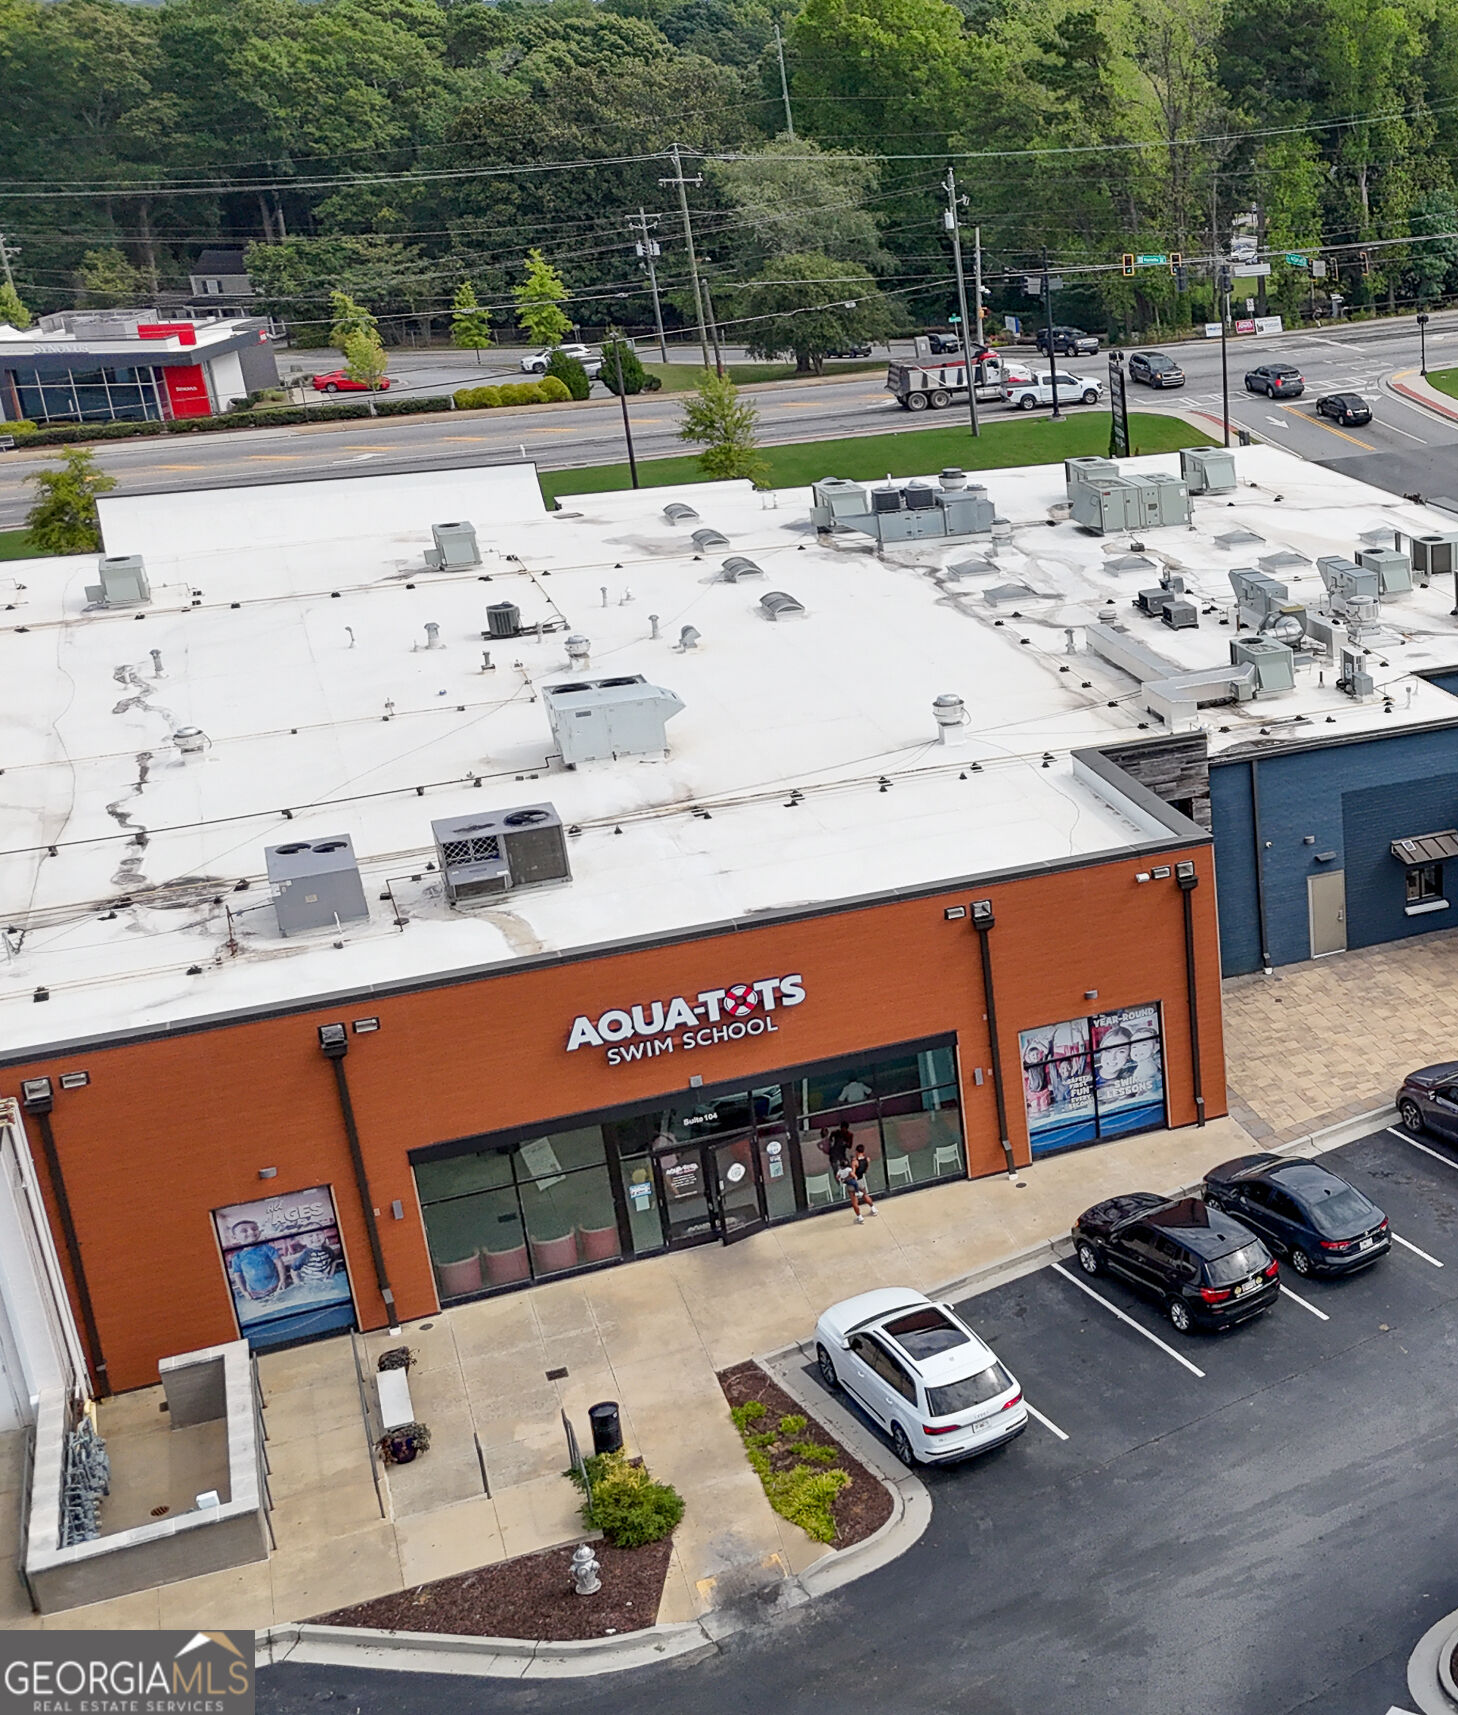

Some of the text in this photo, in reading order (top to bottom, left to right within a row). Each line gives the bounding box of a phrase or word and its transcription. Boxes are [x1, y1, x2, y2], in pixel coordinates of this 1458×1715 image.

[566, 973, 806, 1052] AQUA-TOTS
[1093, 1007, 1154, 1028] YEAR-ROUND
[606, 1016, 779, 1066] SWIM SCHOOL
[1106, 1080, 1153, 1098] LESSONS
[683, 1112, 718, 1126] Suite 104
[272, 1202, 324, 1226] AGES
